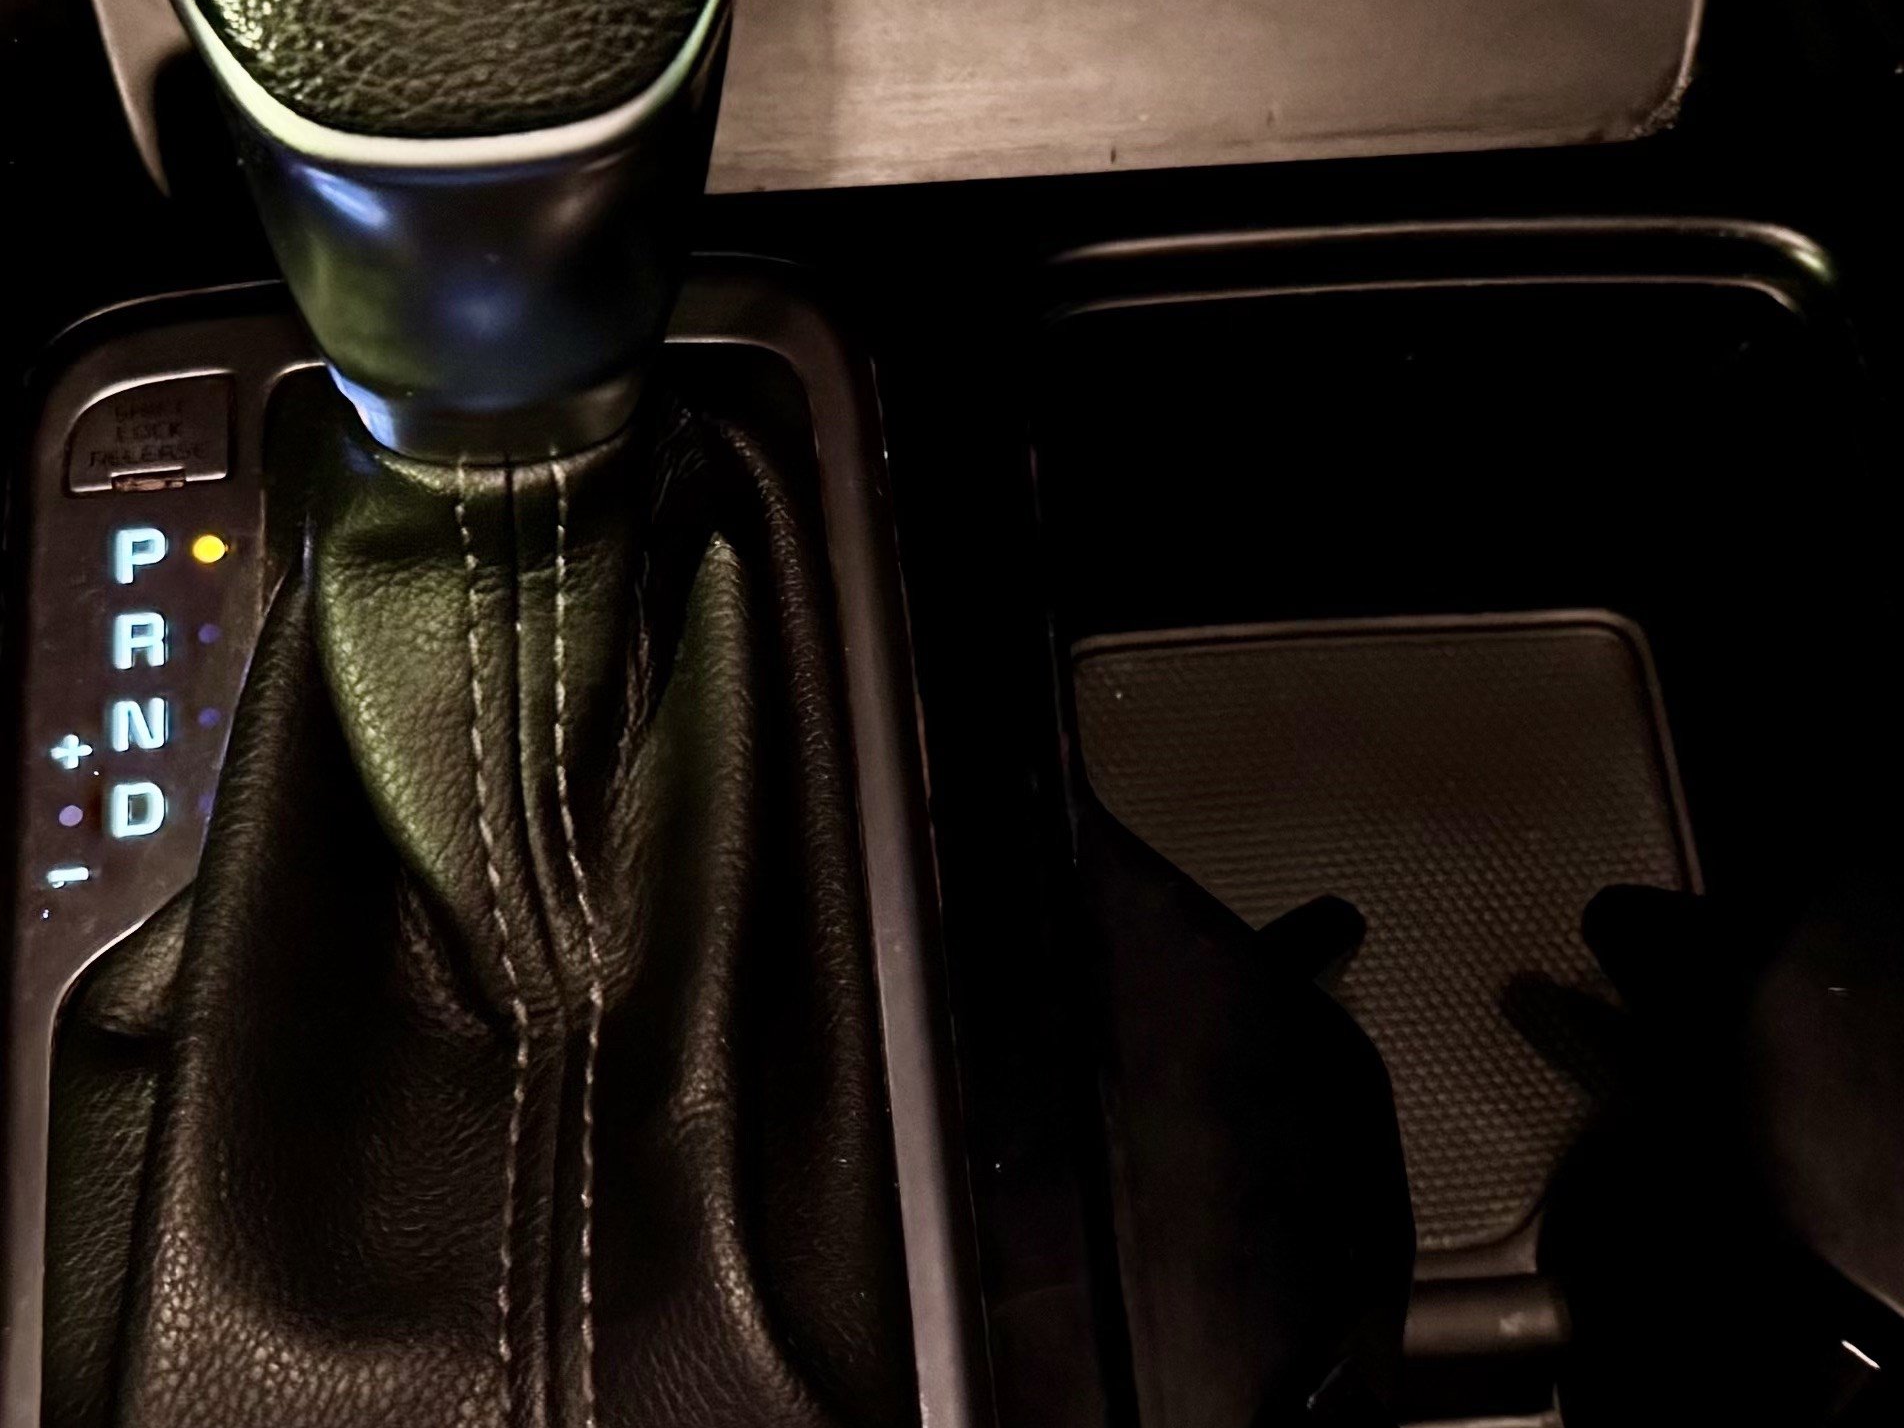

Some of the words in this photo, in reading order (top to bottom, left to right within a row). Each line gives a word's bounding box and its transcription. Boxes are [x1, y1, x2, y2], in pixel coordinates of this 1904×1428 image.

[115, 528, 165, 584] P
[114, 612, 164, 669] R
[112, 698, 164, 752] N
[111, 782, 164, 838] D
